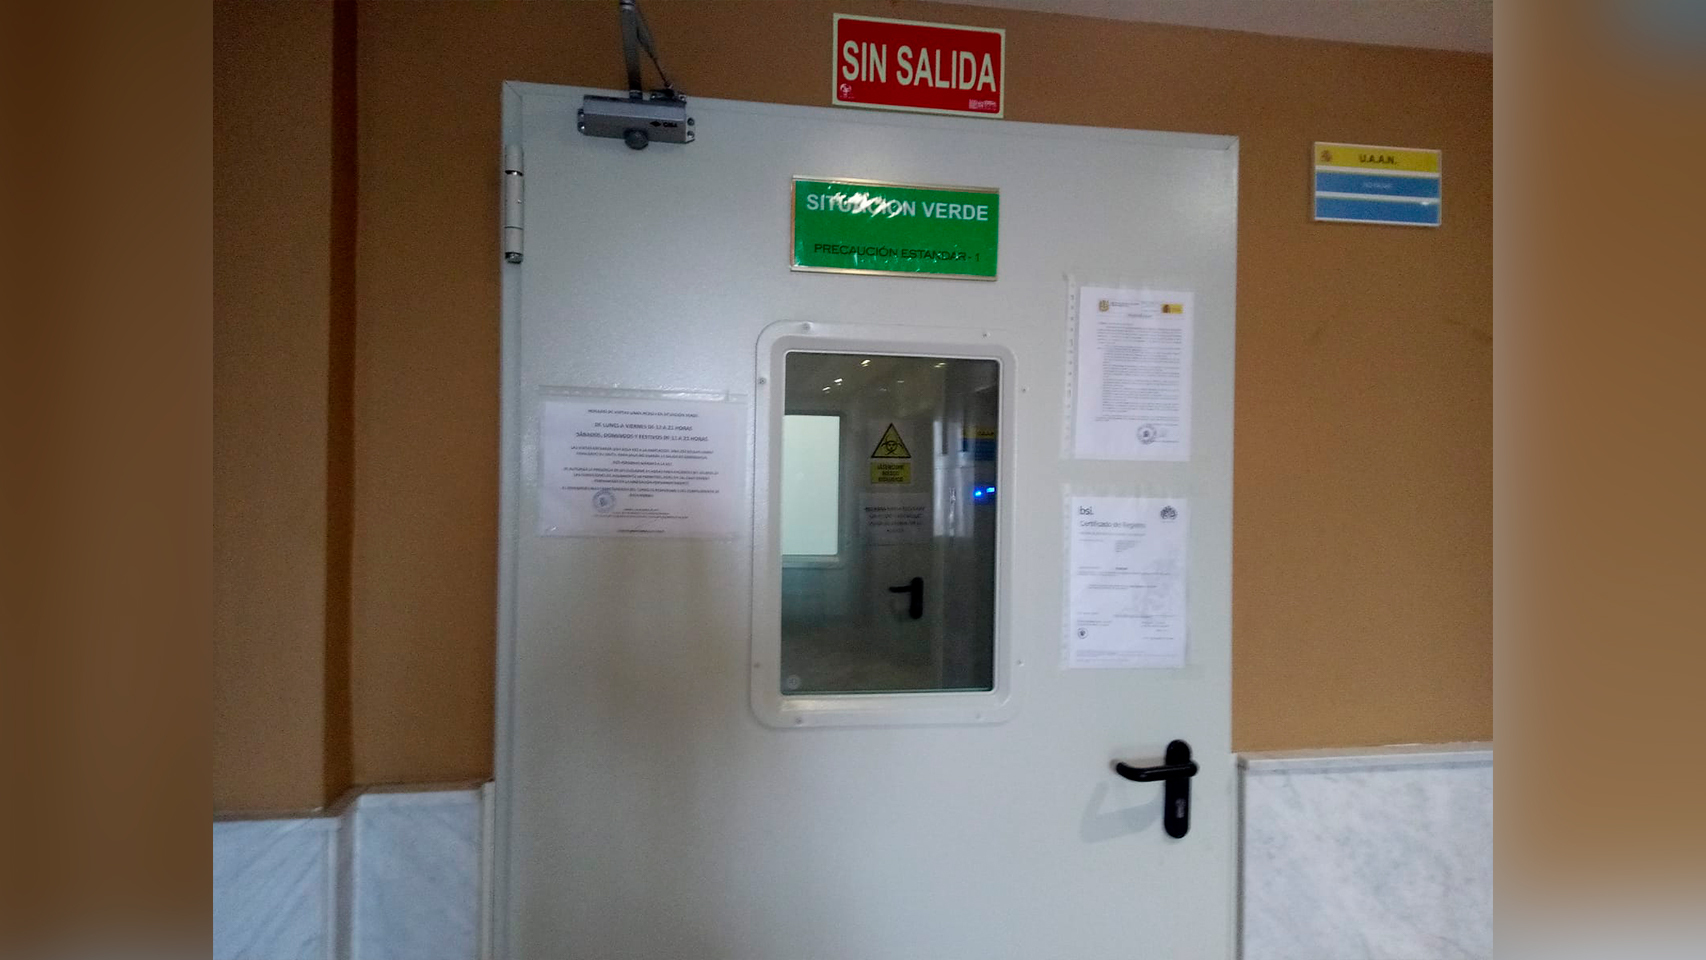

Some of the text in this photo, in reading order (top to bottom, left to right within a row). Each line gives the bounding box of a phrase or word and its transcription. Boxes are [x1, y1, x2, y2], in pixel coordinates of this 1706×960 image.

[842, 40, 997, 92] SIN SALIDA
[922, 201, 989, 222] VERDE
[814, 243, 898, 257] PRECAUCIÓN
